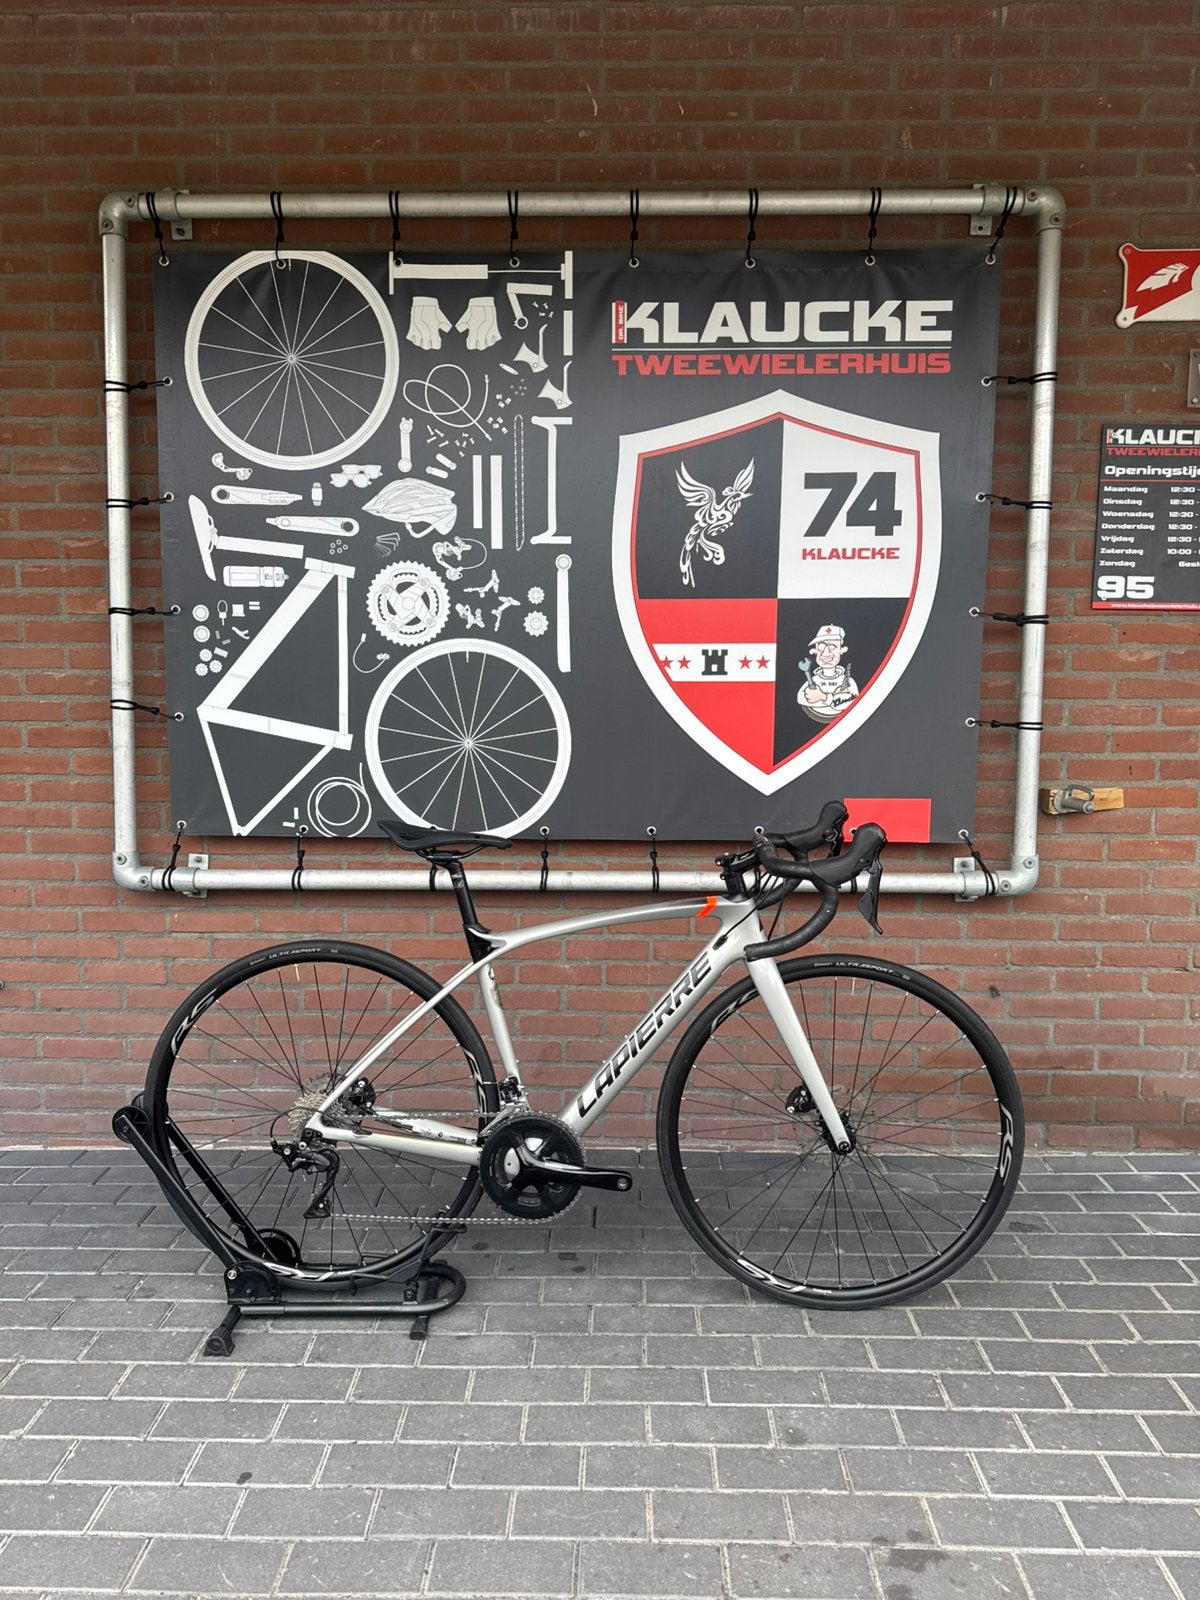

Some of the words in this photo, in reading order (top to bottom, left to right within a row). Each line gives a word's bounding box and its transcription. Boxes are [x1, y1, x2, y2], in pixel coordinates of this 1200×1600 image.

[612, 300, 954, 344] KLAUCKE
[612, 353, 951, 376] TWEEWIELERHUIS
[1106, 448, 1200, 456] TWEEWIELER
[804, 472, 902, 537] 74
[802, 548, 900, 560] KLAUCKE
[1097, 576, 1155, 600] 95
[577, 950, 712, 1118] LAPIERRE
[1000, 1103, 1014, 1186] RS
